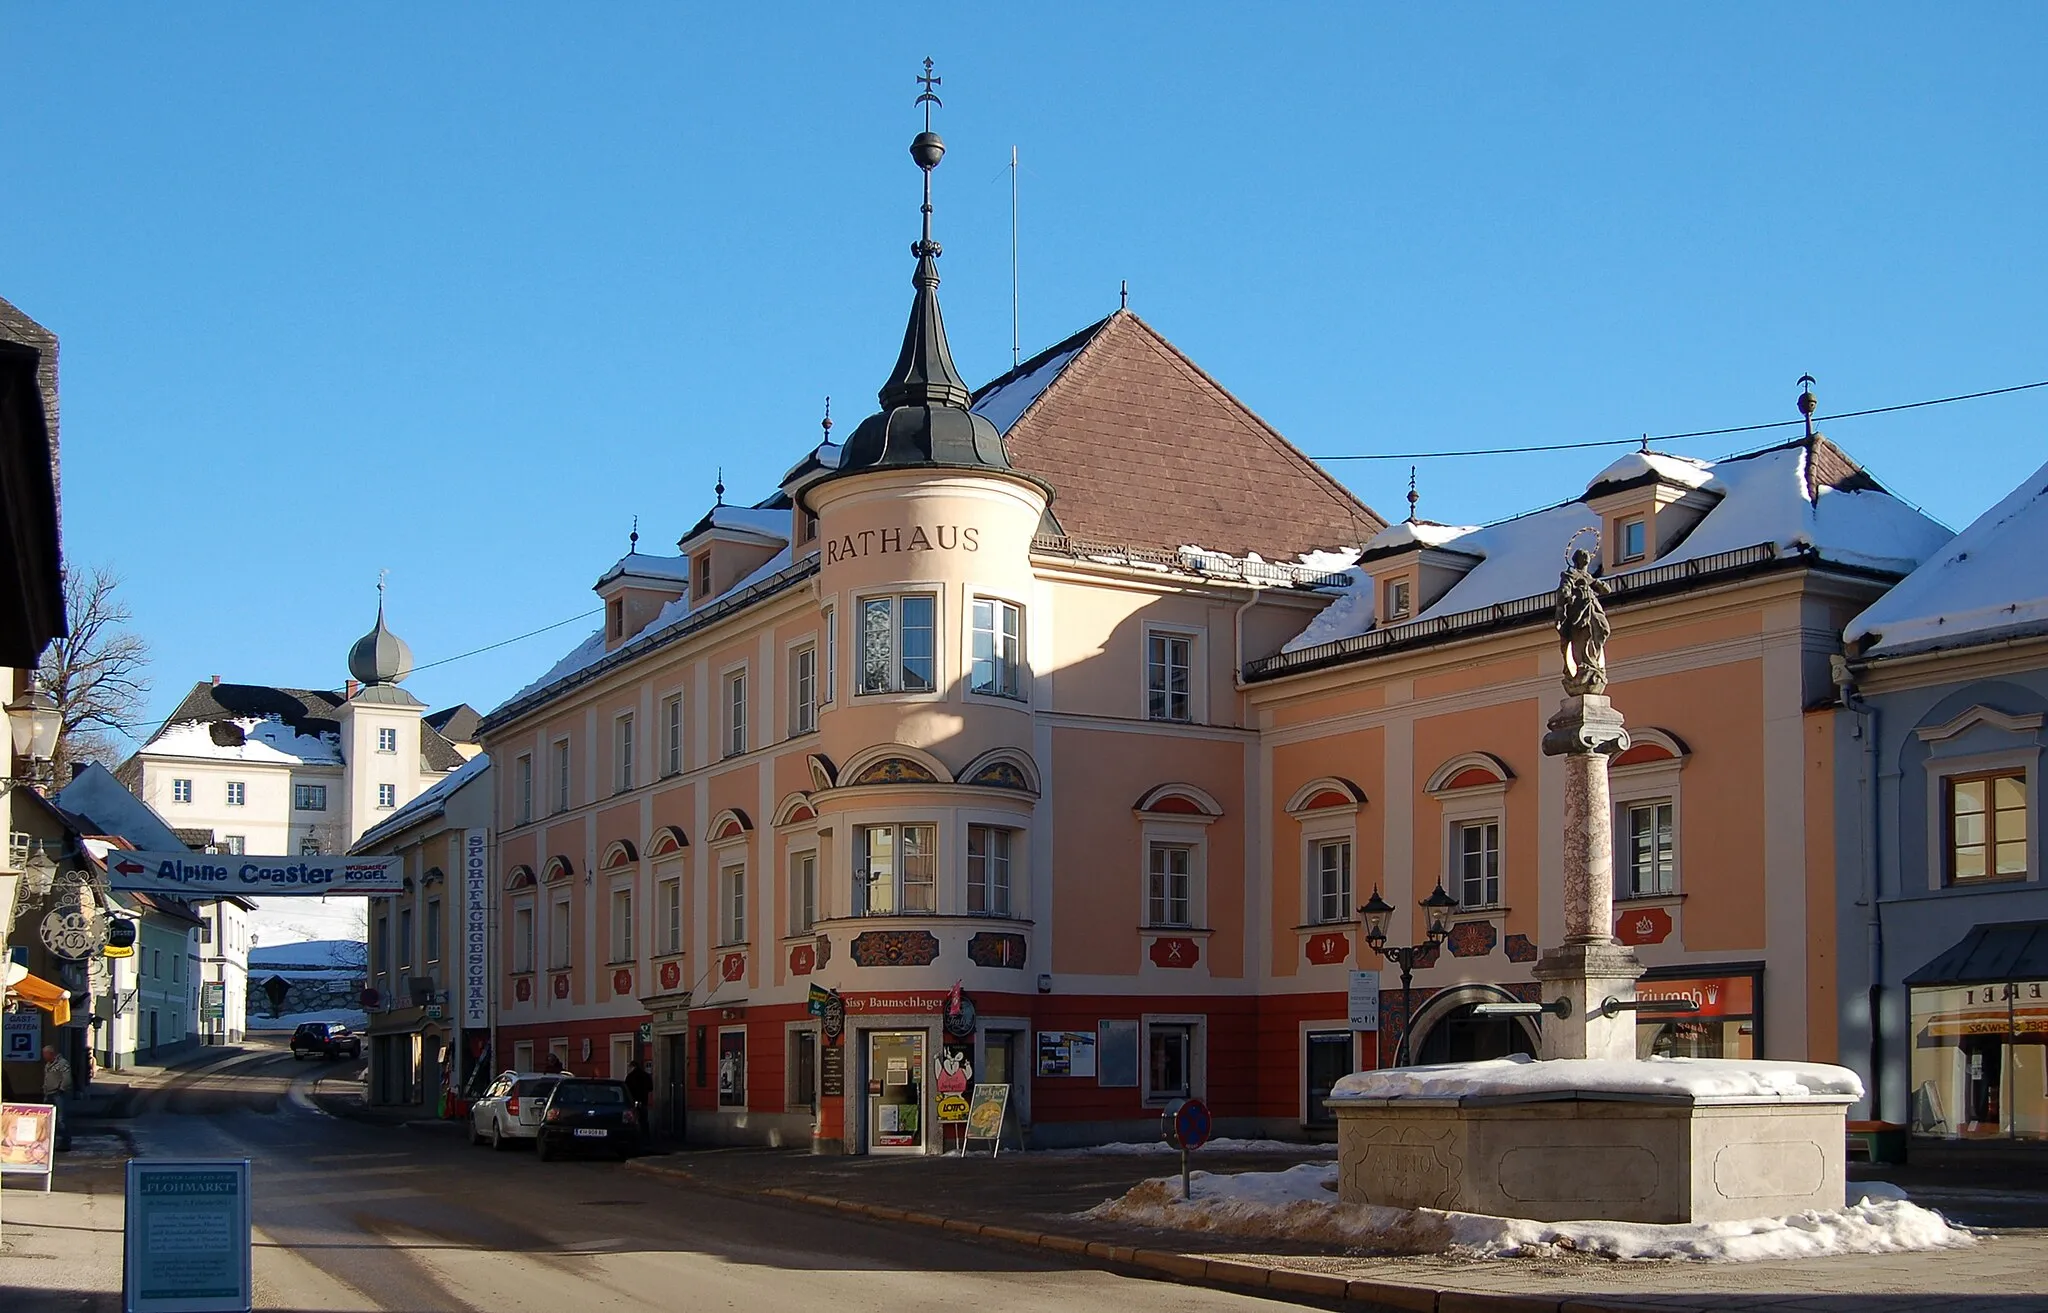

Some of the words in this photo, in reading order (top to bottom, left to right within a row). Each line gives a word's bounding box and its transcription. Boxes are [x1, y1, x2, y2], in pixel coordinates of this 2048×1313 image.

[827, 525, 979, 565] RATHAUS
[157, 859, 228, 884] Alpine
[239, 861, 334, 885] Coaster
[345, 871, 387, 880] KOGEL
[846, 997, 866, 1011] Sissy
[869, 996, 942, 1010] Baumschlager
[15, 1037, 28, 1049] P
[943, 1103, 966, 1112] LOTTO
[1371, 1151, 1432, 1174] ANNO
